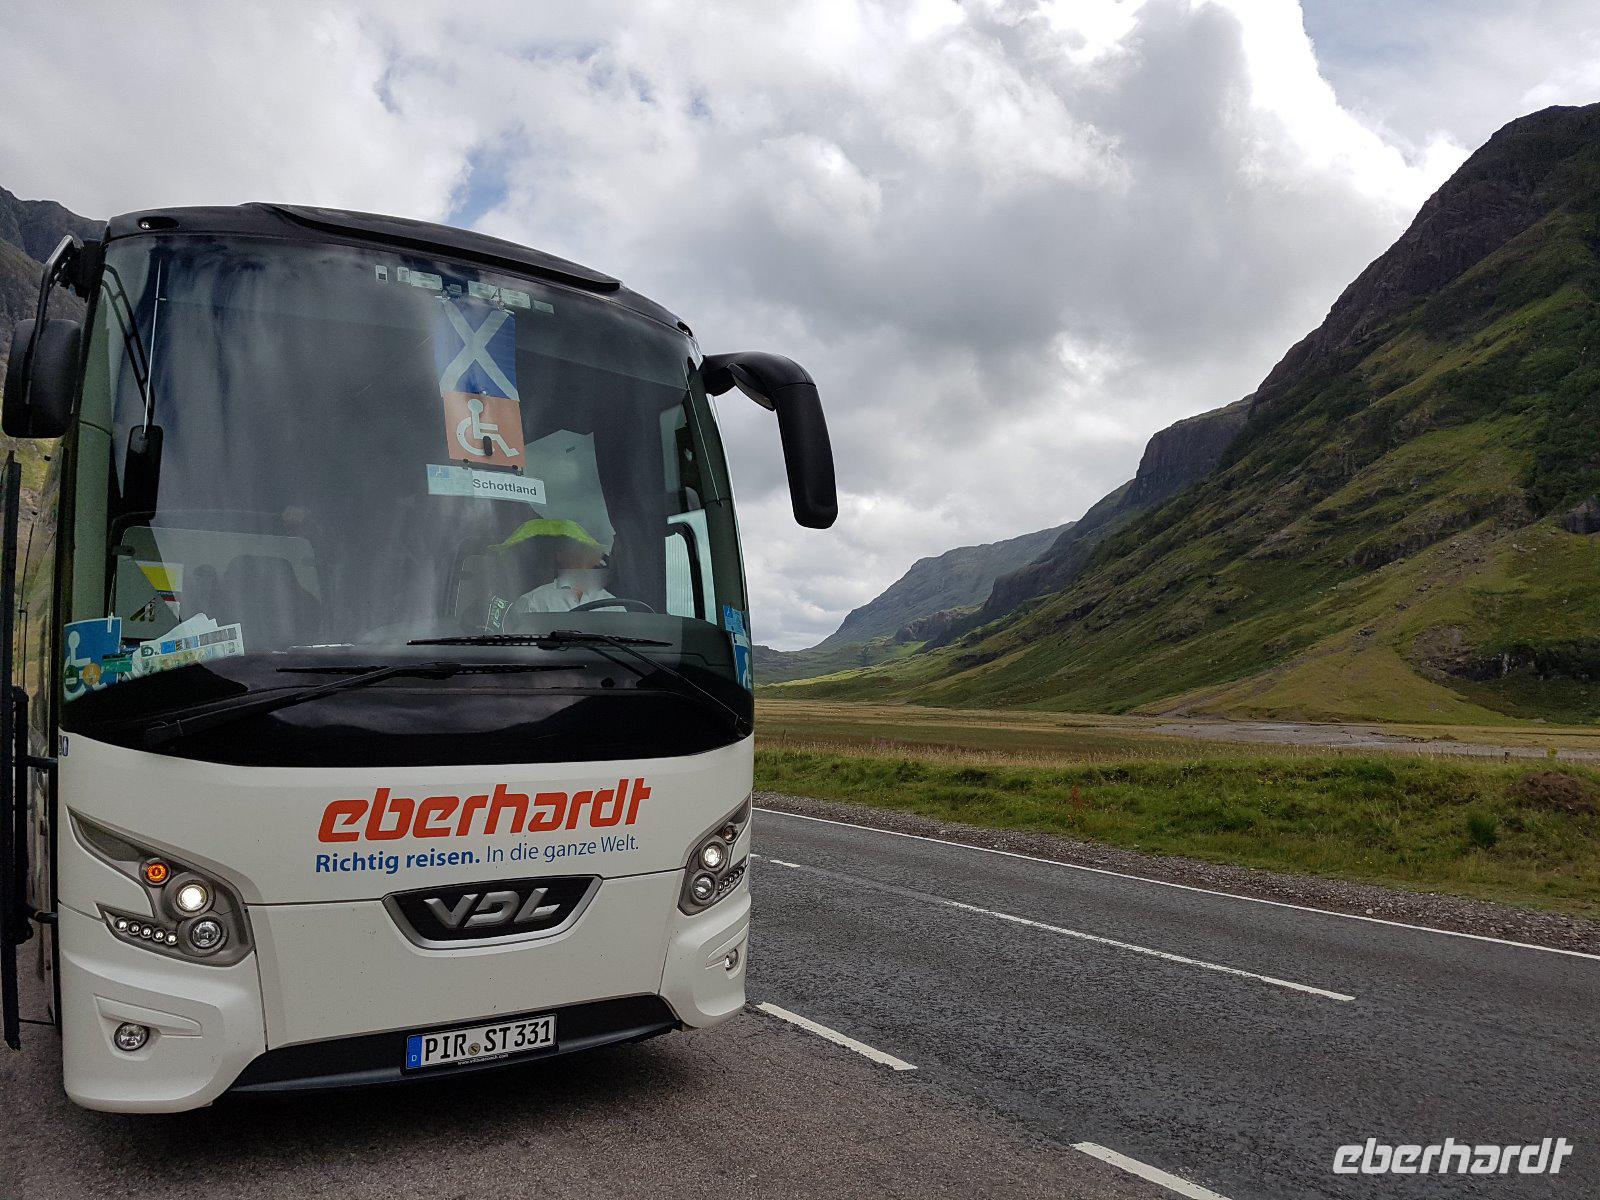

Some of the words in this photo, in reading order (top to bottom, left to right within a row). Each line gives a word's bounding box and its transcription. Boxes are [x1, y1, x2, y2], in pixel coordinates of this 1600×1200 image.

[472, 478, 537, 496] Schottland
[317, 777, 651, 843] eberhardt
[315, 850, 399, 875] Richtig
[406, 847, 480, 868] reisen.
[486, 845, 504, 863] In
[510, 842, 539, 861] die
[544, 841, 597, 863] ganze
[600, 833, 639, 853] Welt.
[423, 887, 561, 929] VDL
[424, 1033, 467, 1062] PIR
